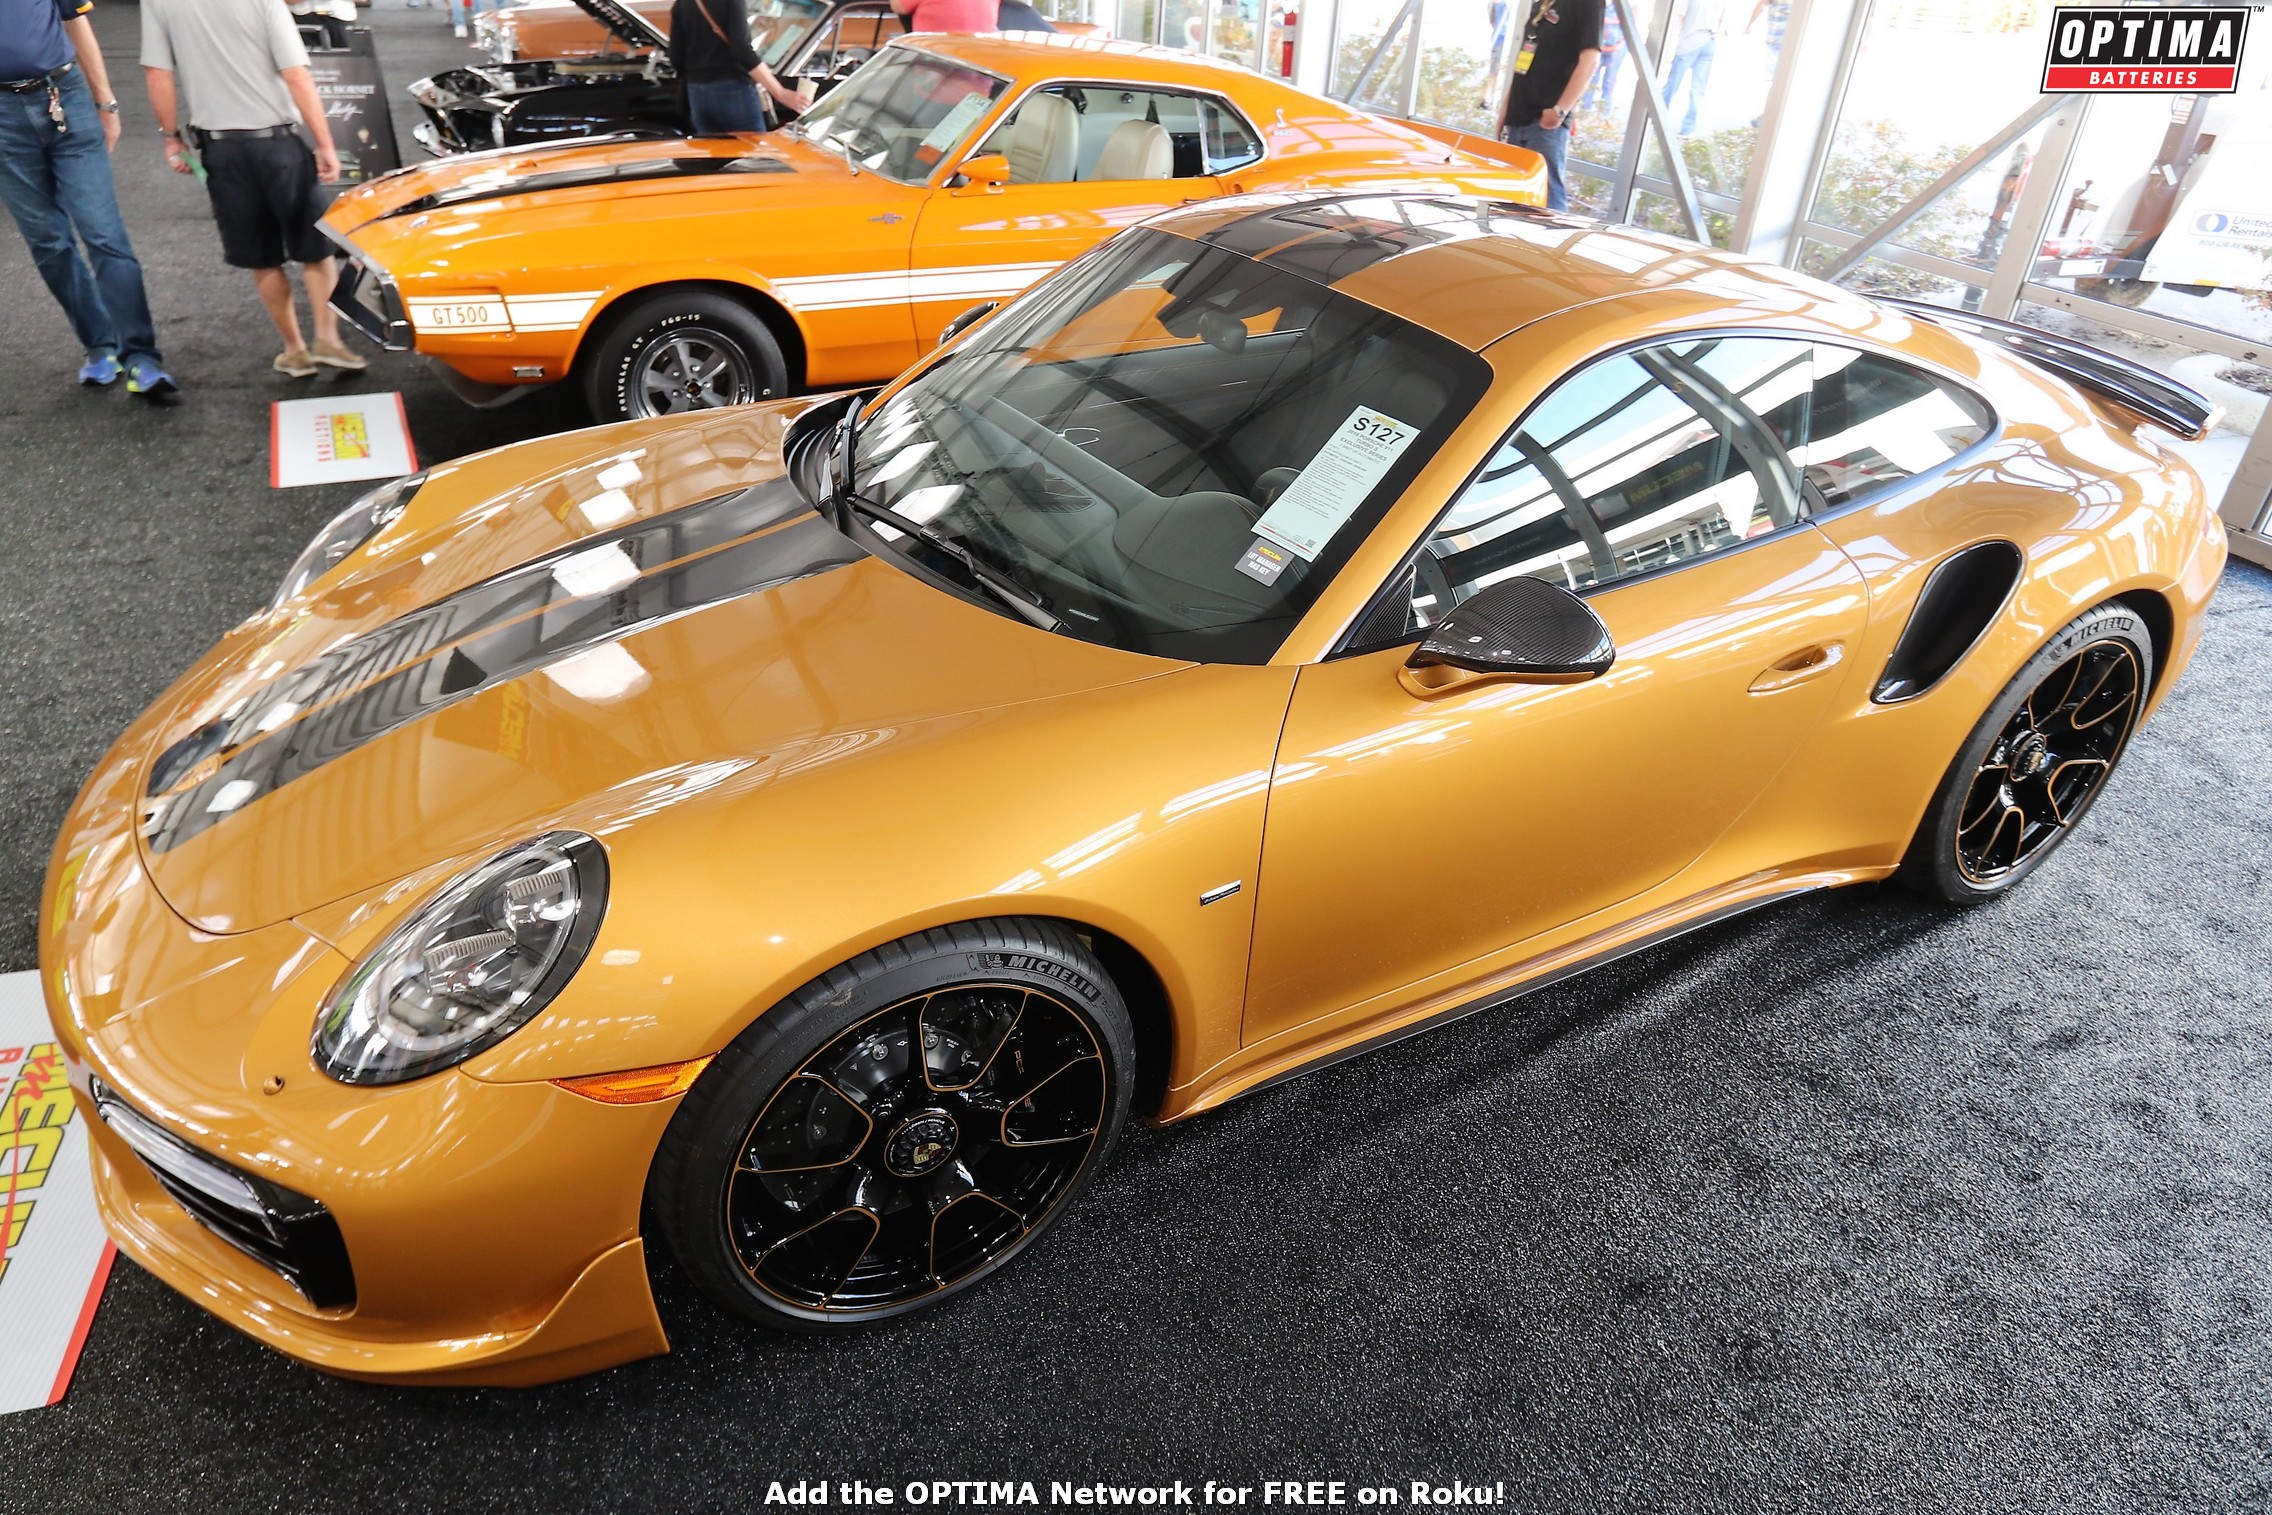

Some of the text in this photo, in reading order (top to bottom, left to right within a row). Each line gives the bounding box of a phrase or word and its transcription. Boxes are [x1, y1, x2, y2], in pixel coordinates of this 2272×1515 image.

[1353, 417, 1405, 445] S127
[1360, 434, 1385, 449] PORSCHE
[1340, 437, 1368, 453] EXCLUSIVE
[1368, 450, 1388, 461] SERIES
[1356, 438, 1374, 450] TURBO
[1247, 551, 1281, 573] LOT MANAGER
[1248, 560, 1270, 576] HAS KEY
[2070, 618, 2132, 646] MICHELIN
[1008, 955, 1098, 999] MICHELIN
